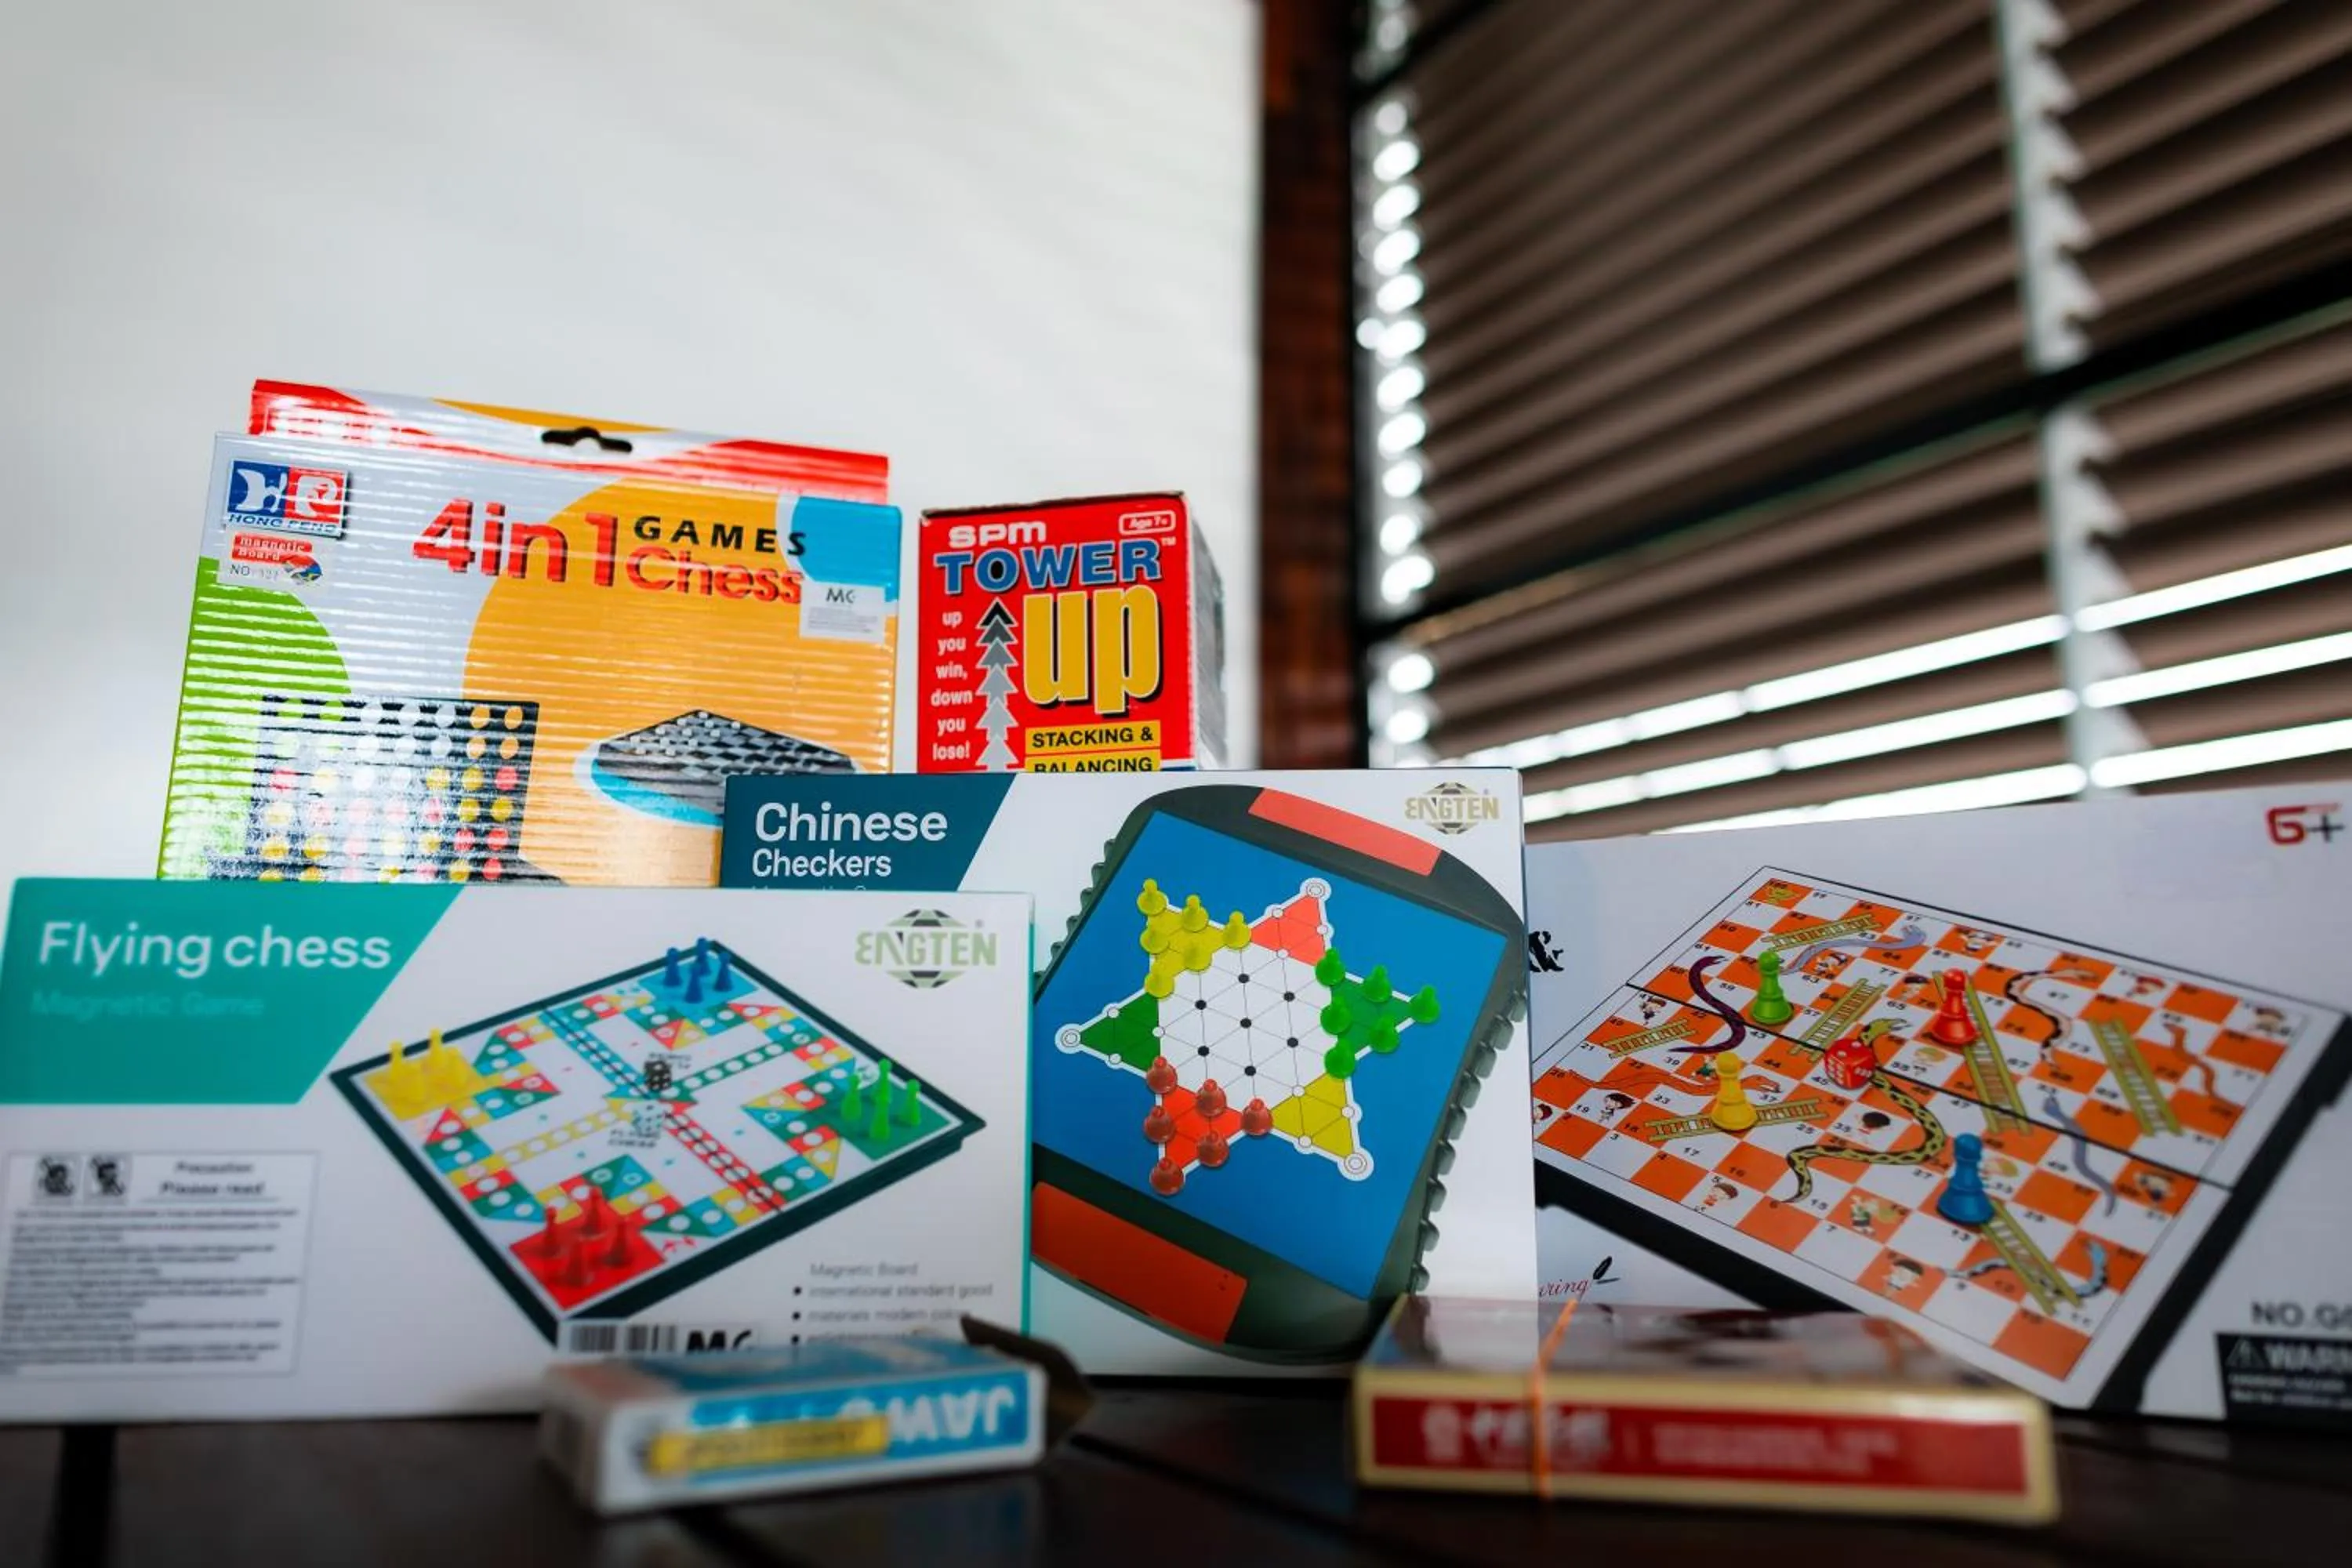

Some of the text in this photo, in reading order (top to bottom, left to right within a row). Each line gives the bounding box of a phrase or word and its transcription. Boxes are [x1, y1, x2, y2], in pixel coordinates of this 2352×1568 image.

[634, 516, 806, 556] GAMES
[627, 546, 804, 604] Chess
[935, 539, 1162, 595] TOWER
[942, 612, 962, 628] up
[938, 637, 966, 656] you
[1023, 585, 1163, 717] up
[936, 663, 967, 681] win,
[931, 690, 972, 707] down
[938, 718, 966, 737] you
[1033, 728, 1153, 748] STACKING &
[933, 743, 970, 760] lose!
[1034, 757, 1152, 772] BALANCING
[755, 801, 948, 841] Chinese
[752, 848, 891, 877] Checkers
[38, 921, 390, 978] Flying chess
[30, 990, 264, 1020] Magnetic Game
[1654, 1095, 1671, 1105] 23
[160, 1181, 220, 1195] Please
[810, 1262, 919, 1278] Magnetic Board
[897, 1284, 955, 1297] standard
[959, 1283, 993, 1299] good
[874, 1309, 927, 1321] modern
